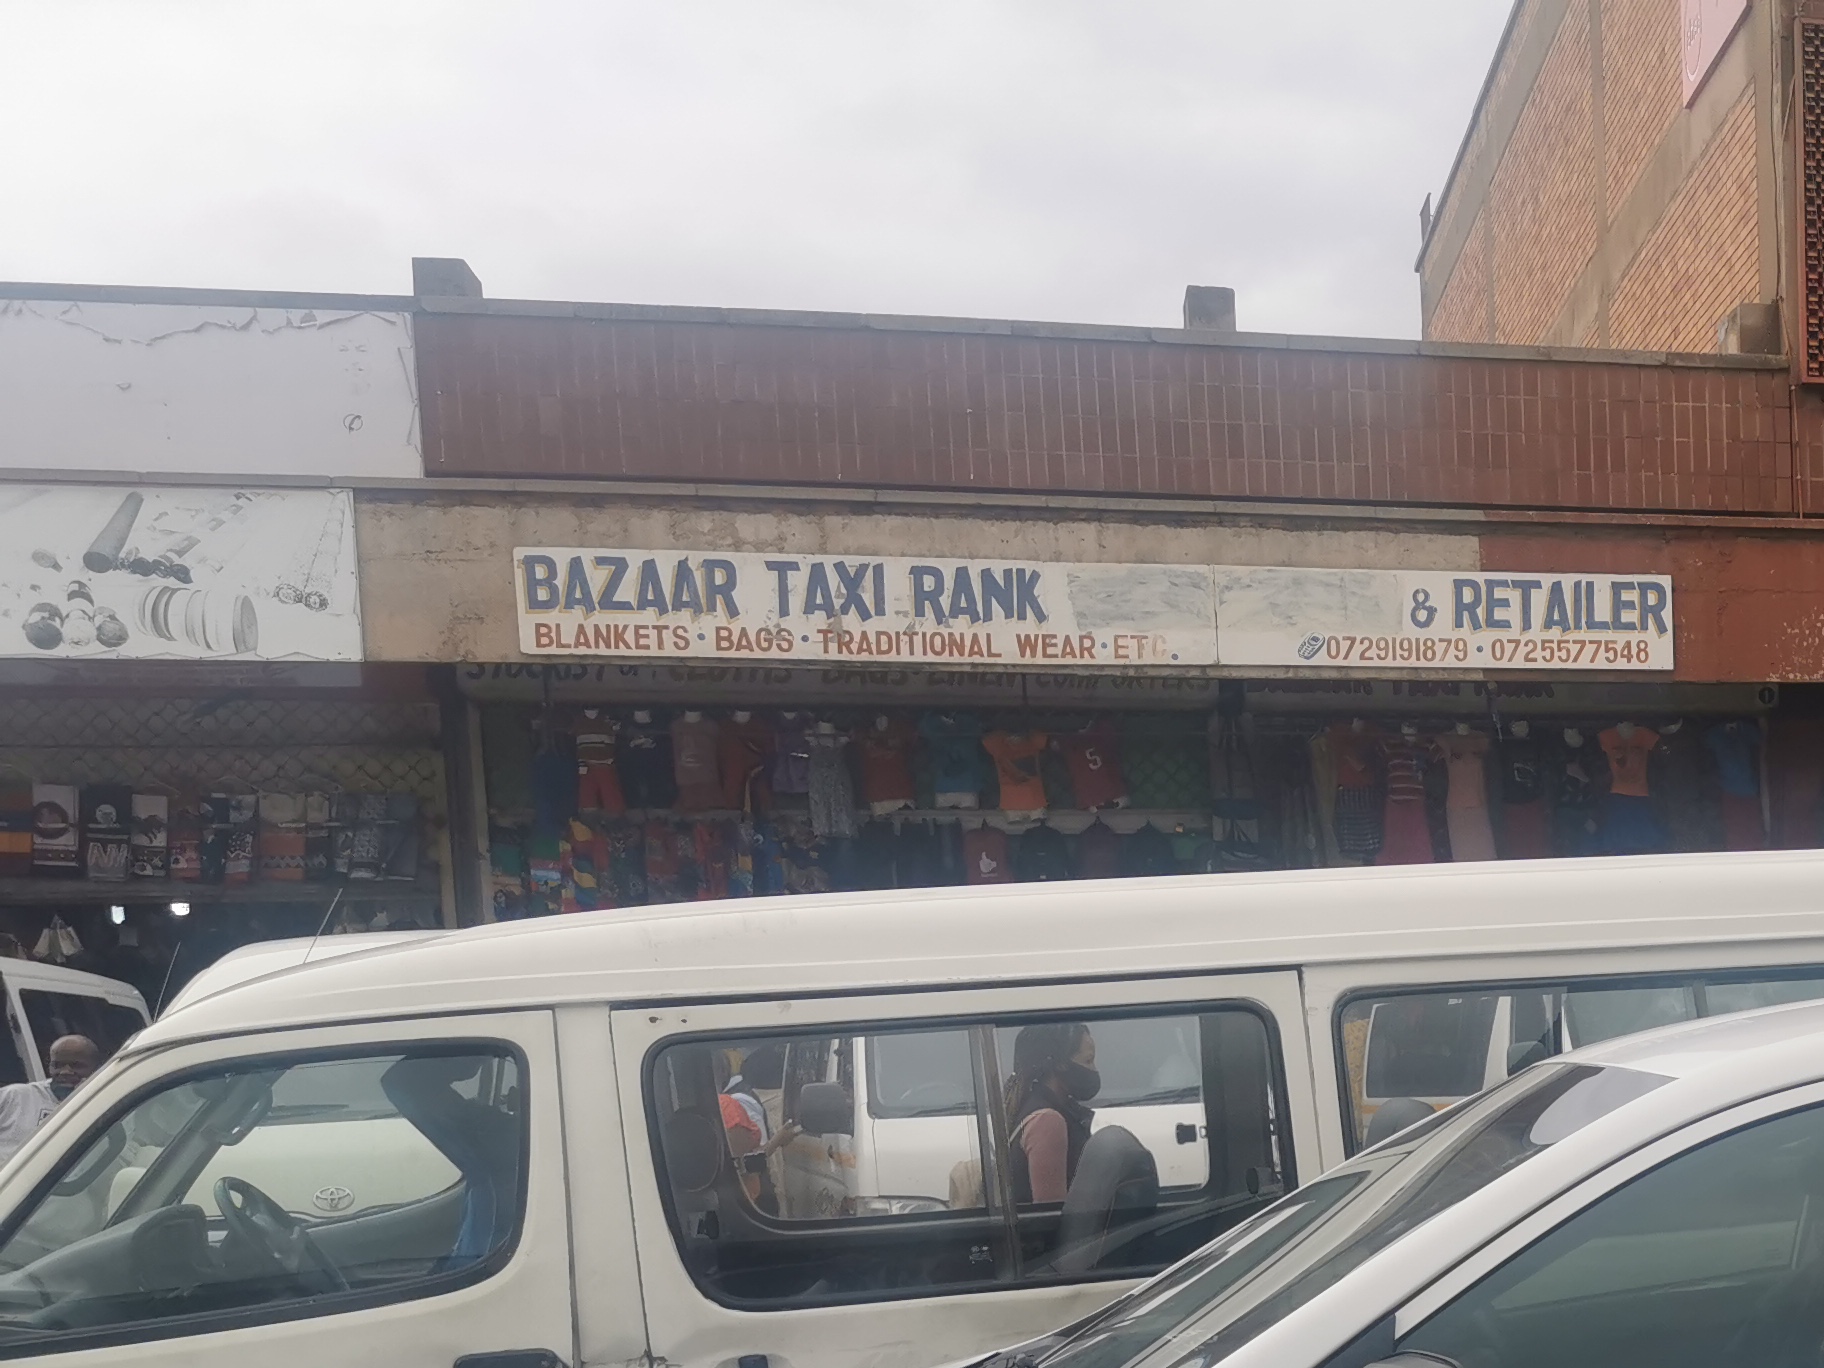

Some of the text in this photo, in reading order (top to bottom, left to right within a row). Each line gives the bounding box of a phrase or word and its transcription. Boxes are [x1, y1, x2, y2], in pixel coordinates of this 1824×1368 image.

[519, 554, 1669, 637] BAZAAR TAXI RANK & RETAILER
[534, 622, 690, 651] BLANKETS
[715, 627, 795, 653] BAGS
[817, 628, 1002, 660] TRADITIONAL
[1016, 632, 1096, 660] WEAR
[1326, 636, 1650, 665] 0729191879 0725577548
